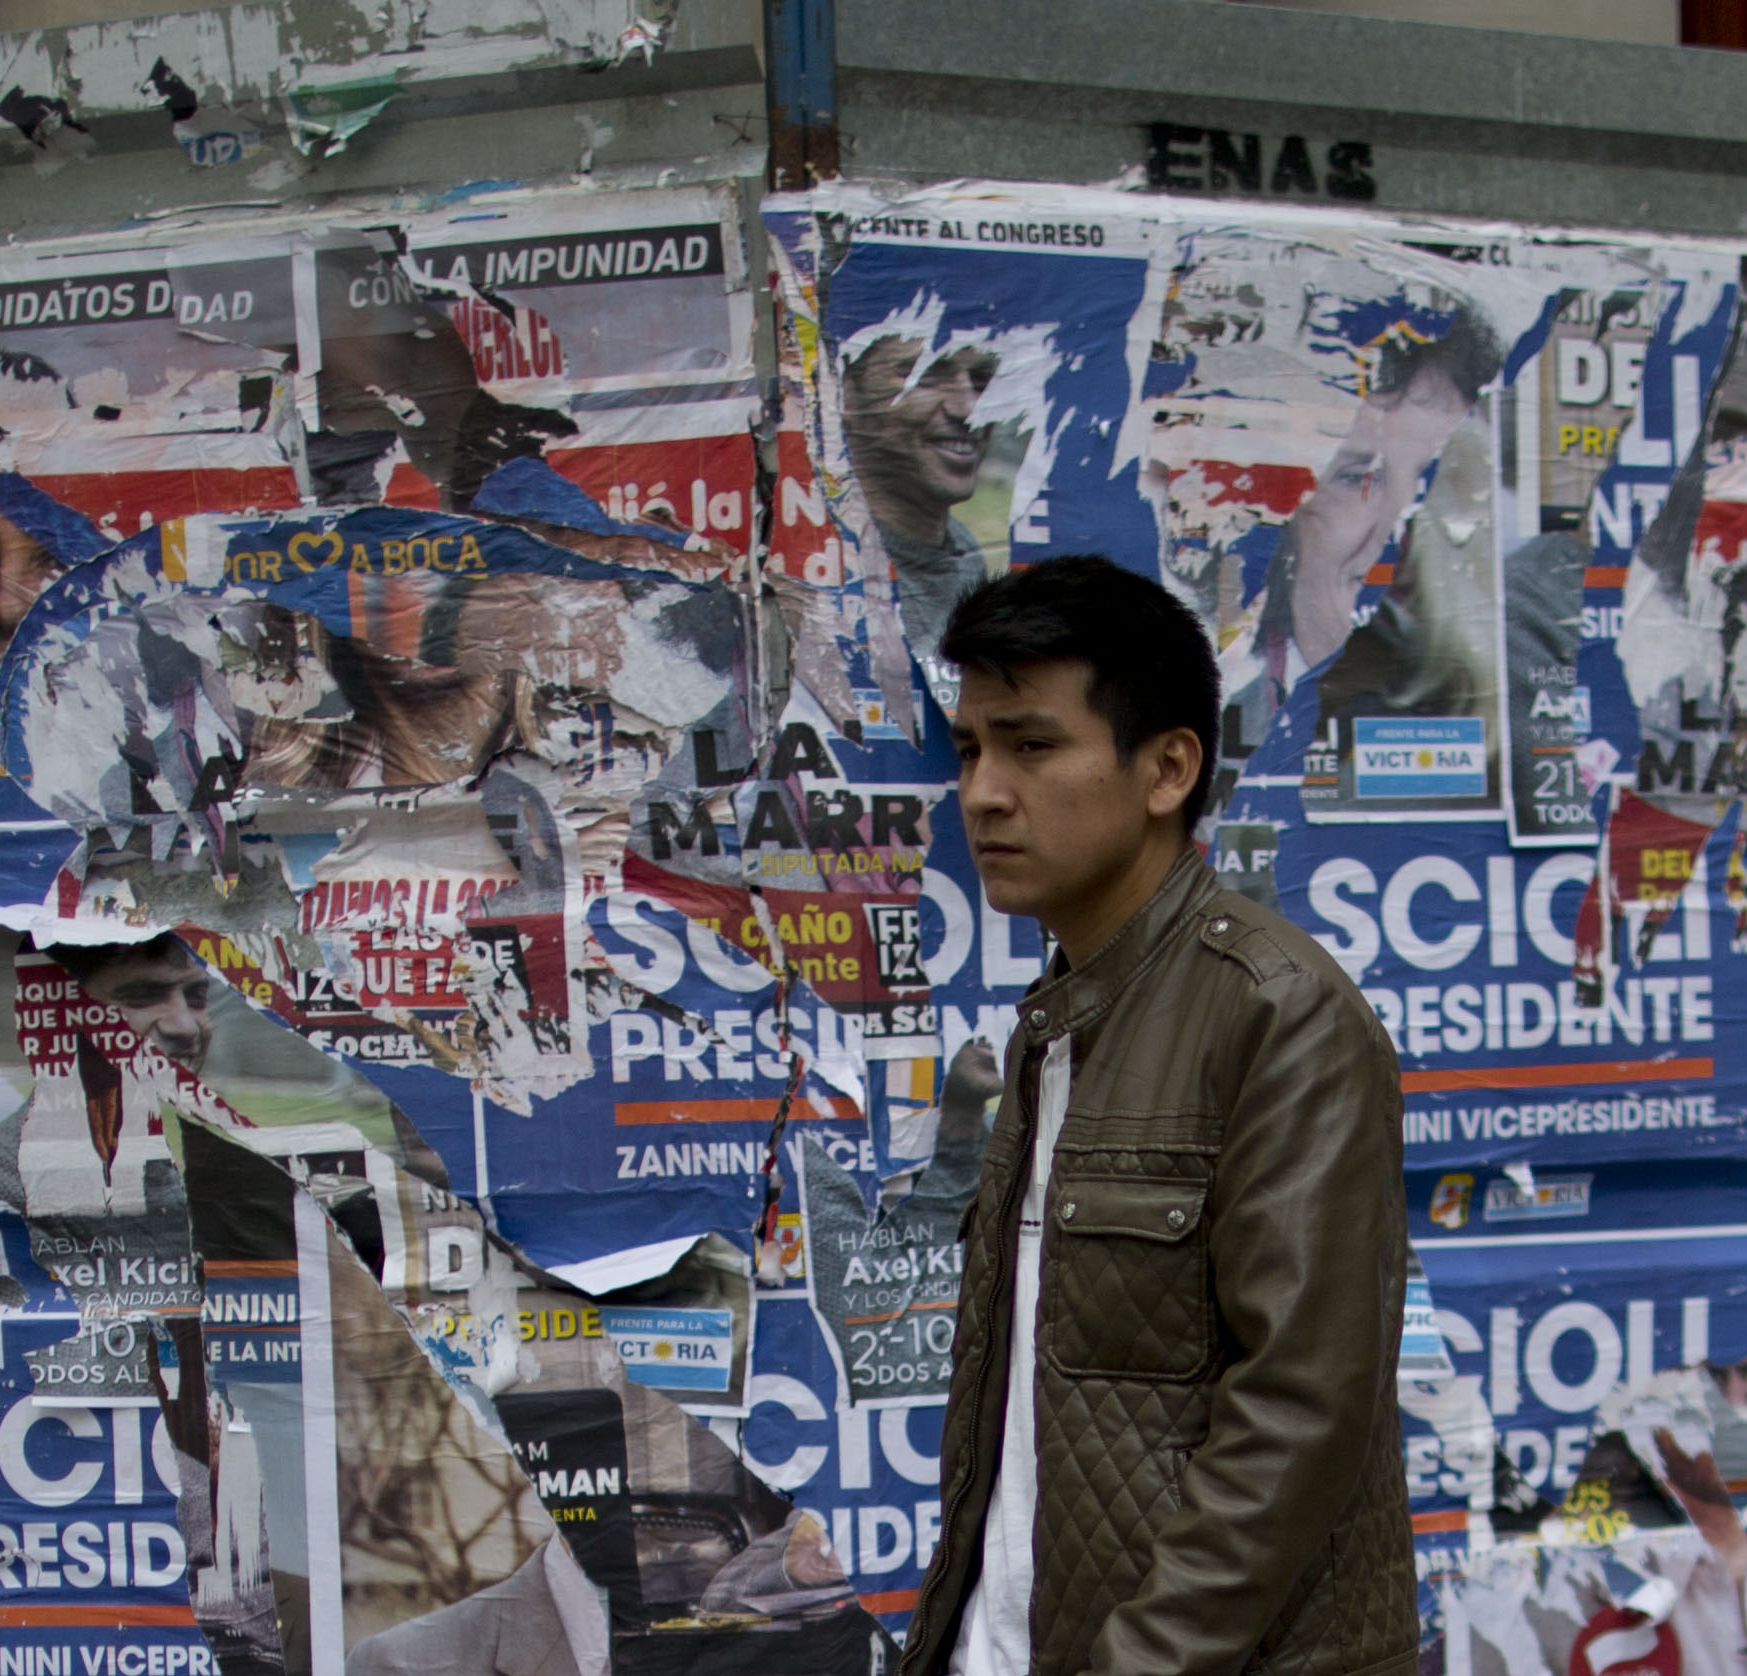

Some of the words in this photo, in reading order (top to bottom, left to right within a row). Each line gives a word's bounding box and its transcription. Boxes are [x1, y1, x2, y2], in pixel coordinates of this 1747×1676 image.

[1150, 122, 1375, 200] ENAS
[977, 221, 1104, 248] CONGRESO
[484, 234, 709, 288] IMPUNIDAD
[380, 534, 489, 577] BOCA
[1459, 1096, 1716, 1140] VICEPRESIDENTE
[228, 1341, 258, 1362] LA
[114, 1364, 149, 1385] AL
